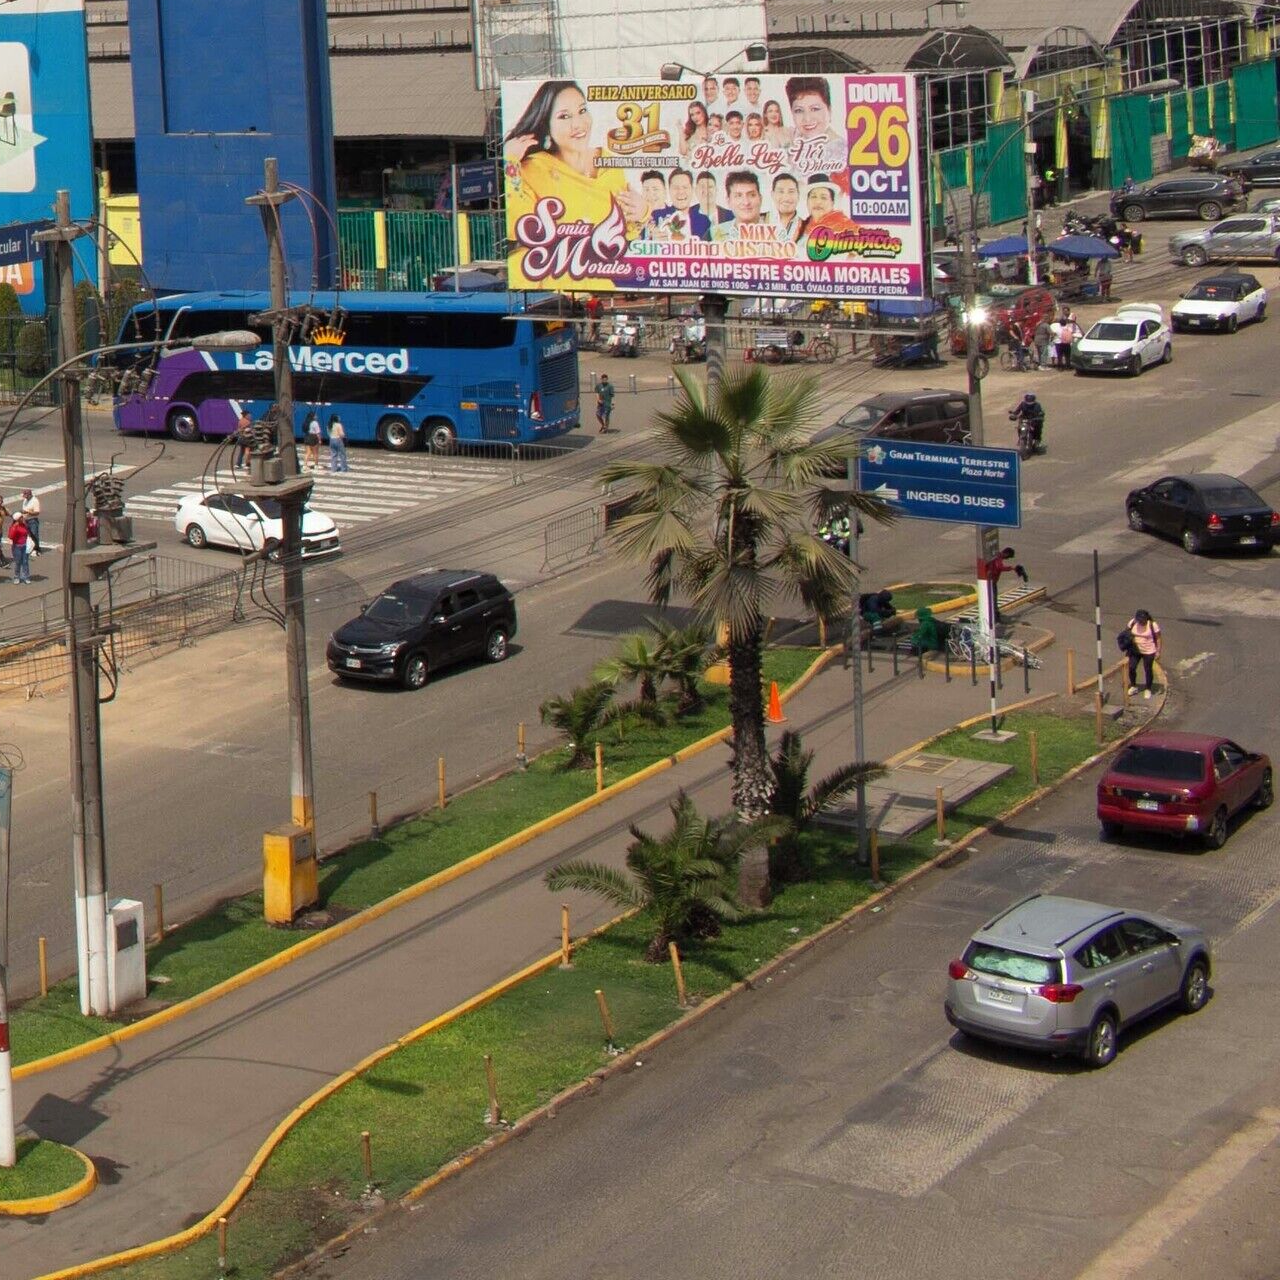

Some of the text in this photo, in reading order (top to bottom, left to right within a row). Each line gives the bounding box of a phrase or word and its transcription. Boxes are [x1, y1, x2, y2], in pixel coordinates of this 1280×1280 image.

[588, 84, 697, 100] FELIZ ANIVERSARIO
[848, 83, 904, 103] DOM.
[846, 105, 911, 169] 26
[690, 142, 744, 169] Bella
[851, 169, 908, 193] OCT.
[854, 201, 907, 215] 10:00AM
[648, 261, 911, 285] CLUB CAMPESTRE SONIA MORALES
[235, 349, 274, 371] La
[889, 449, 1010, 469] GRAN TERMINAL TERRESTRE
[961, 467, 983, 477] Plaza
[906, 490, 1006, 509] INGRESO BUSES
